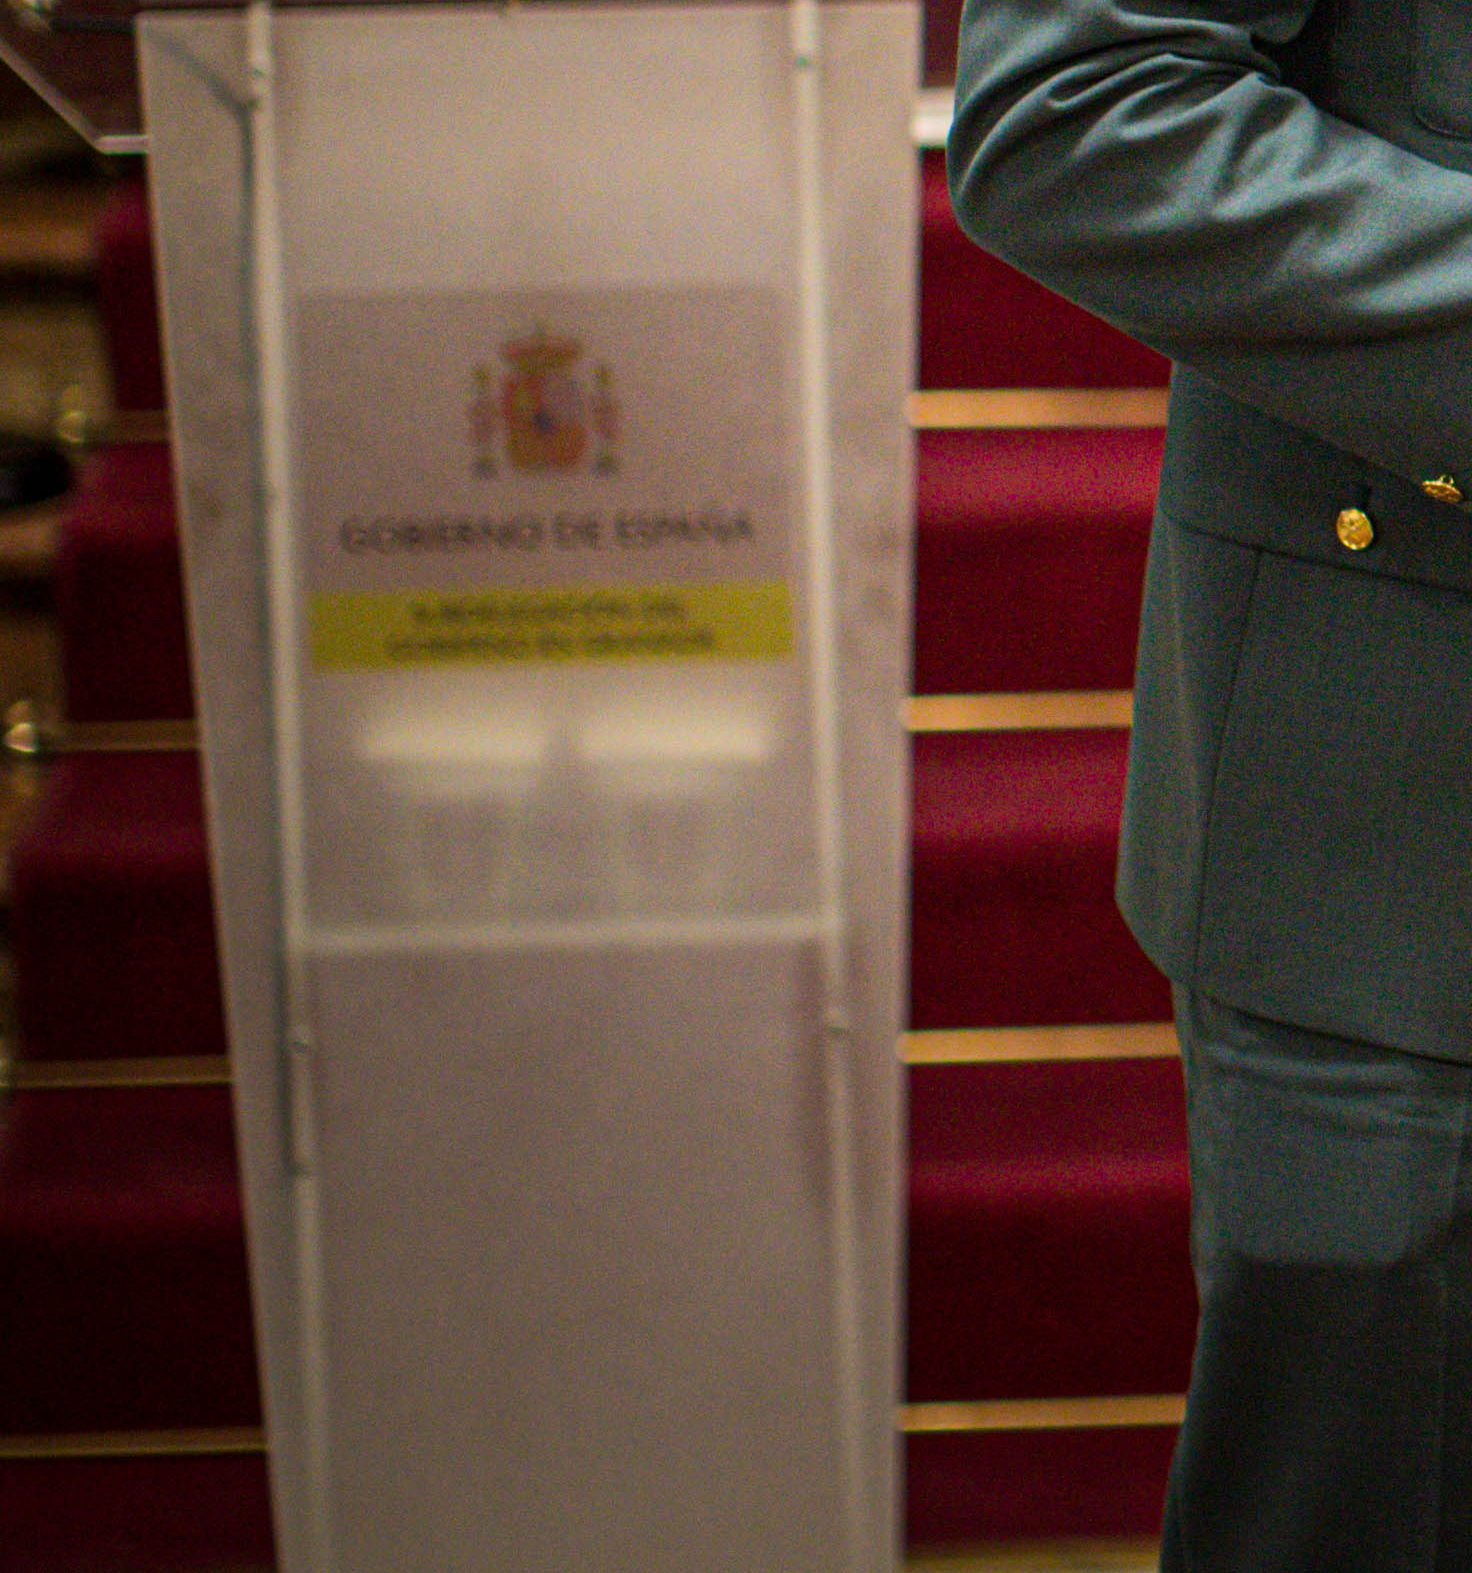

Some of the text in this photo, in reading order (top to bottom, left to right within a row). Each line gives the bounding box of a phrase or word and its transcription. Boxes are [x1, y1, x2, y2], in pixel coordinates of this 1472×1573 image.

[338, 500, 755, 554] GOBIERNO DE ESPAÑA
